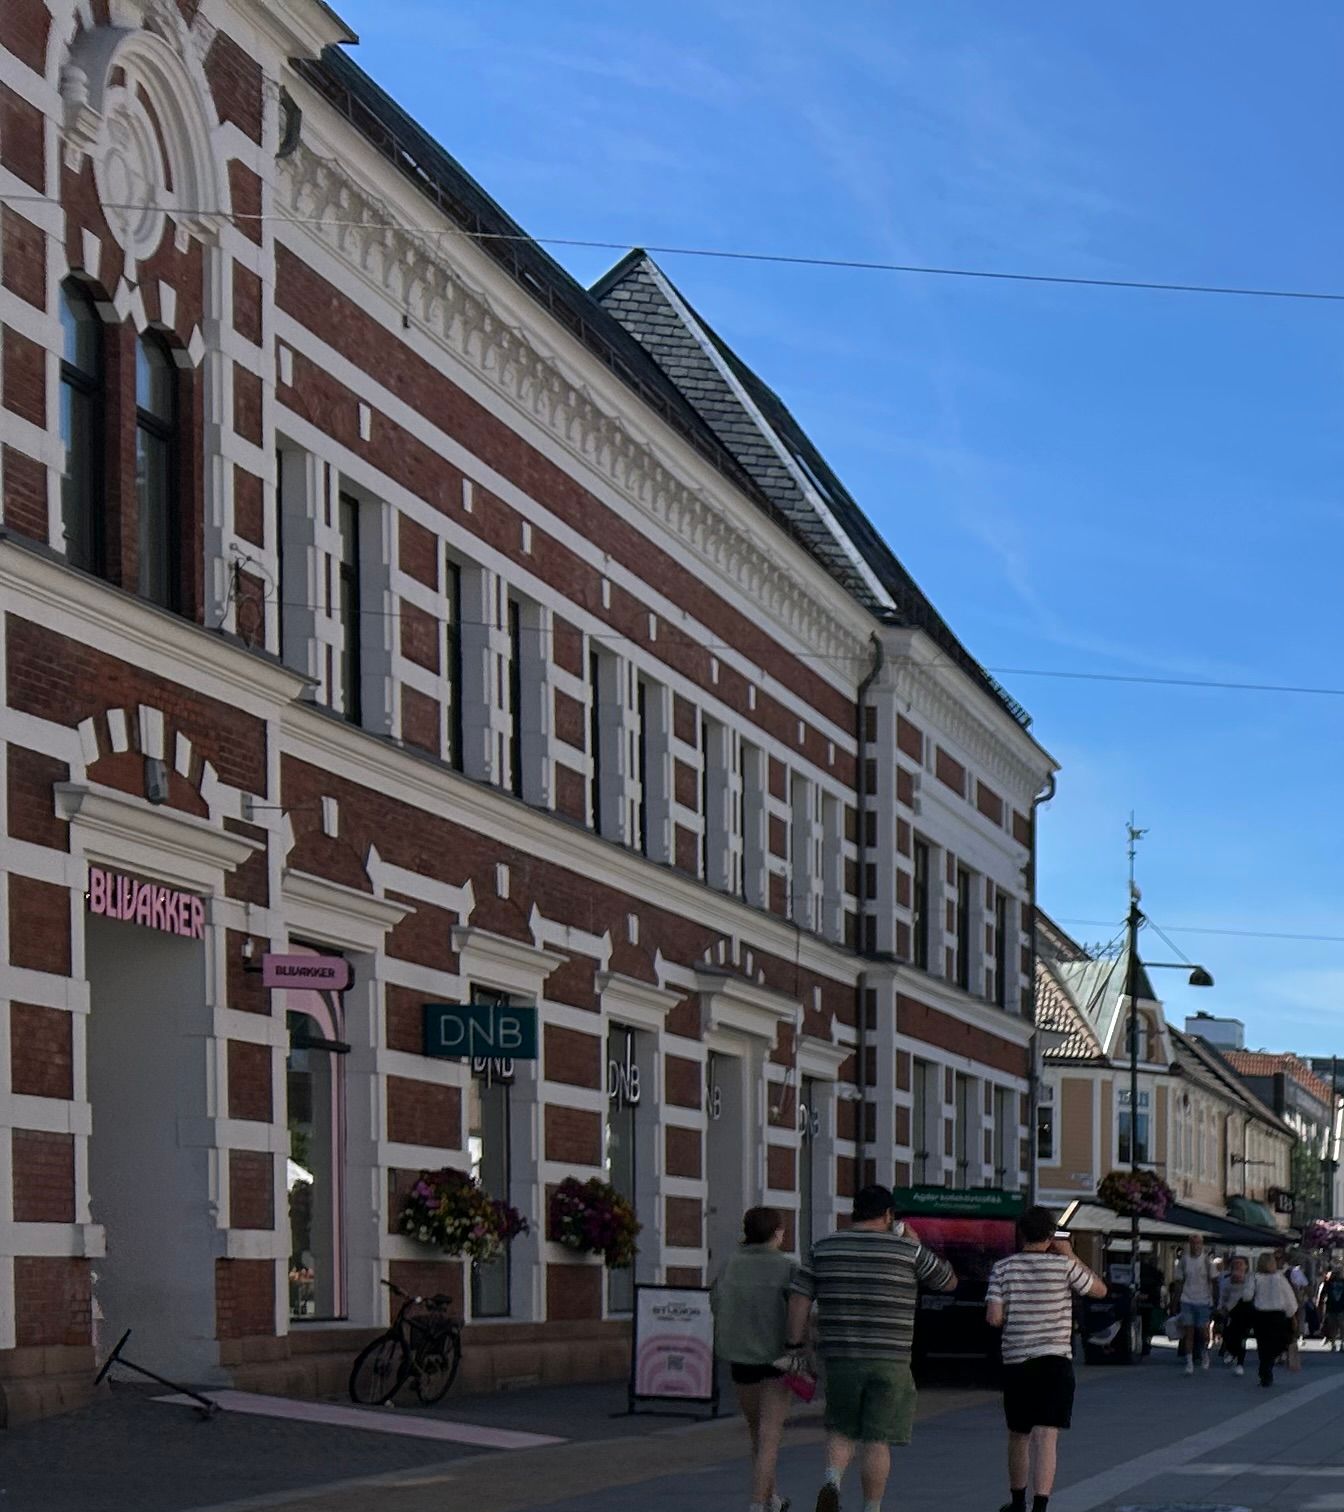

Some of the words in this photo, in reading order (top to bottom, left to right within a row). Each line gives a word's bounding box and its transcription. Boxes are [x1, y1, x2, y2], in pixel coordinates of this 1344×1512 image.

[90, 867, 206, 941] BLIVAKKER
[275, 965, 336, 979] BLIVAKKER
[440, 1004, 523, 1058] DNB
[609, 1028, 641, 1112] DNB
